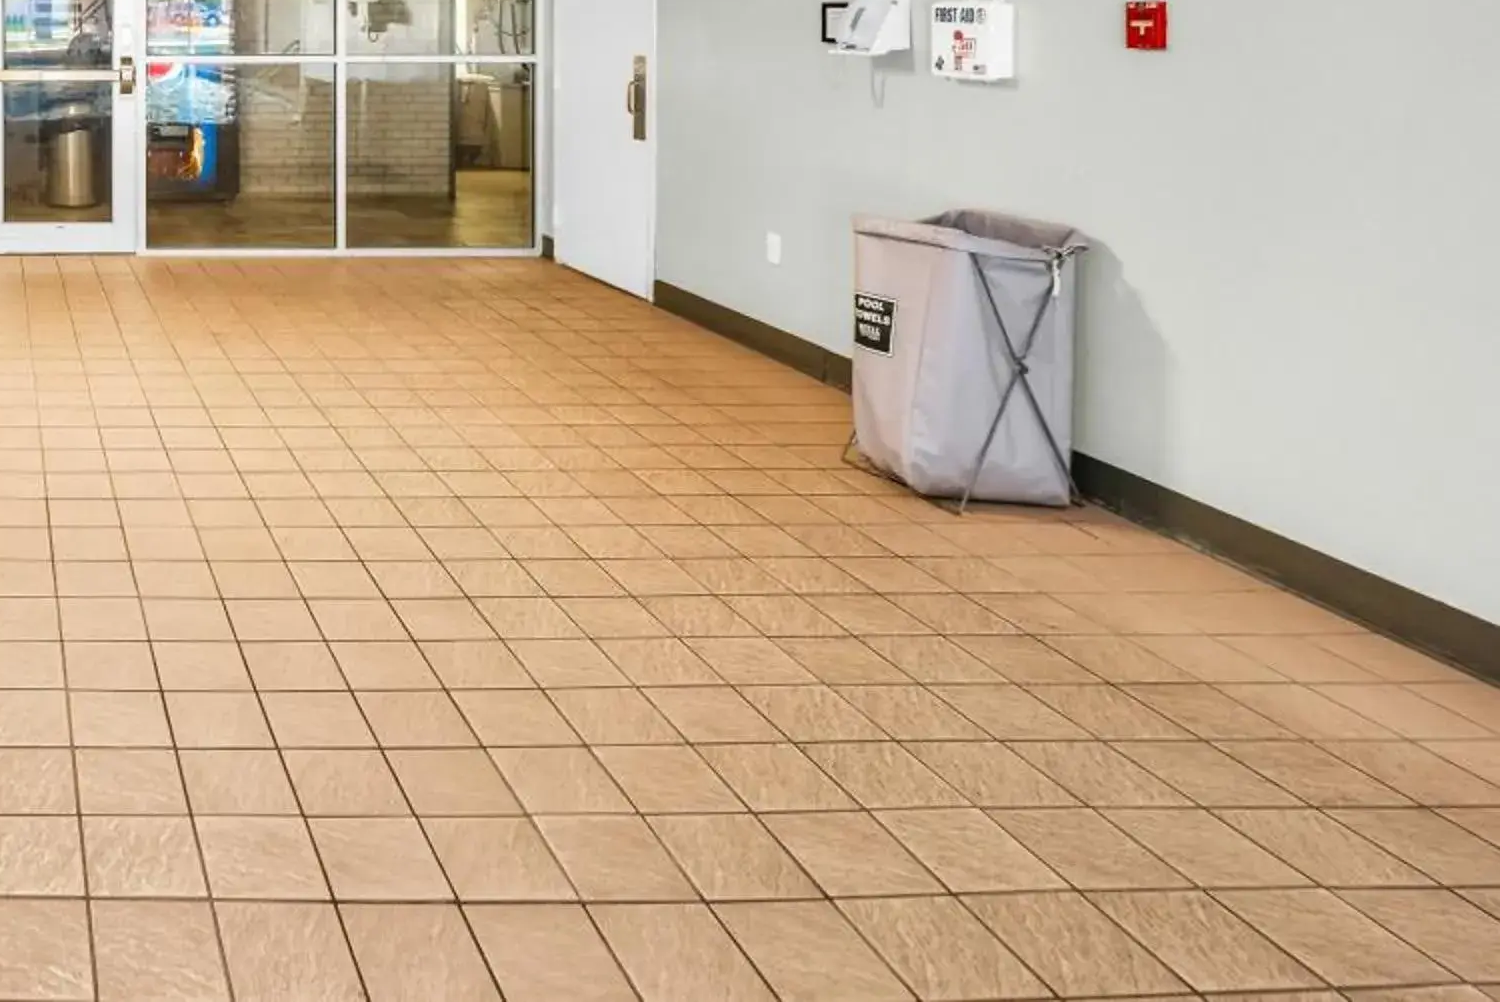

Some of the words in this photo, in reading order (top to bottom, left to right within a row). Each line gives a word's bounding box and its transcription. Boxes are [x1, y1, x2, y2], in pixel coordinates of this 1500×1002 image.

[935, 7, 957, 23] FIRST
[959, 7, 975, 23] AID
[858, 297, 885, 311] POOL
[855, 309, 891, 326] OWELS
